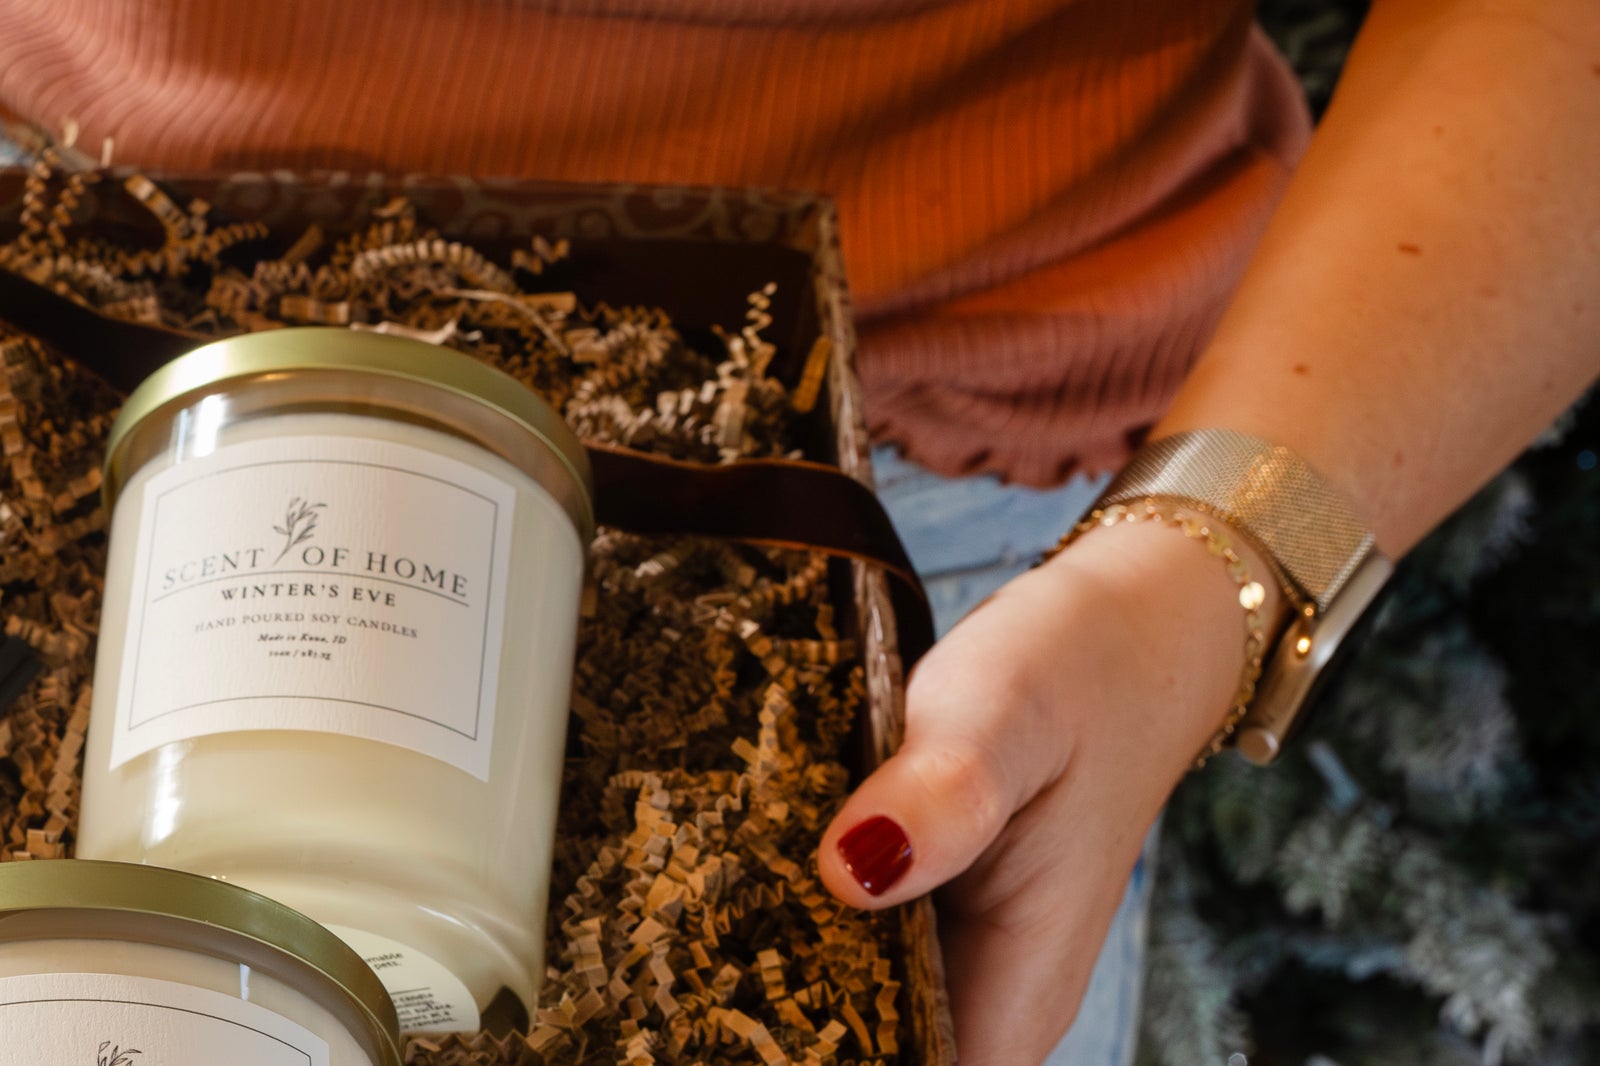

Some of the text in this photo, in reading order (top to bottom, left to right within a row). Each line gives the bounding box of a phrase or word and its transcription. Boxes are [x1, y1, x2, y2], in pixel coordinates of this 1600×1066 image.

[162, 546, 468, 598] SCENT OF HOME
[221, 583, 396, 607] WINTER'S EVE
[195, 612, 418, 639] HAND POURED SOY CANDLES
